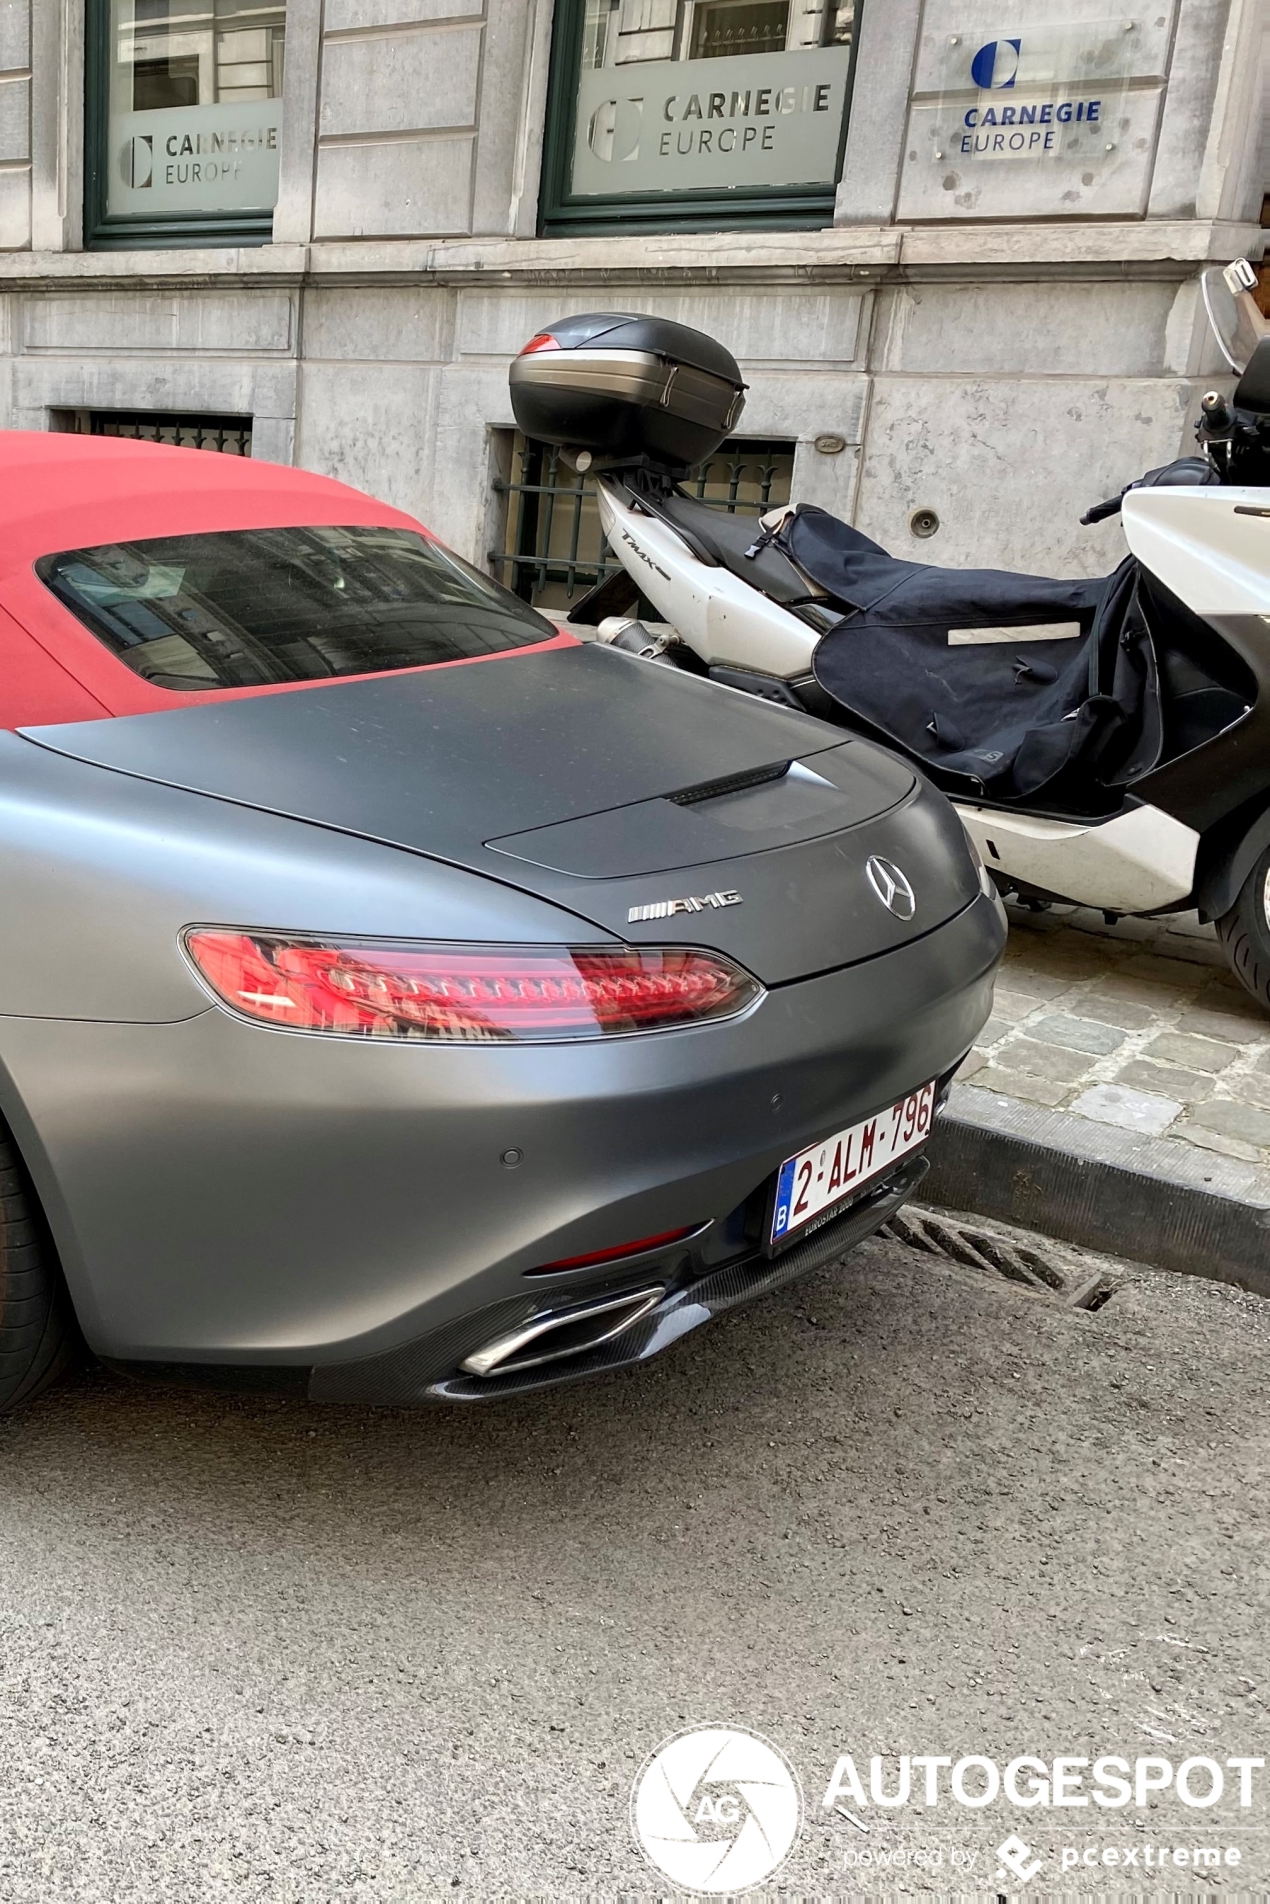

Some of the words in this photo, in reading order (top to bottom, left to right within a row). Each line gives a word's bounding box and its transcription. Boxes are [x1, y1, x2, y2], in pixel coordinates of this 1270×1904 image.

[663, 84, 831, 122] CARNEGIE
[964, 101, 1102, 128] CARNEGIE
[659, 125, 776, 156] EUROPE
[960, 131, 1056, 153] EUROPE
[667, 889, 744, 917] AMG
[776, 1204, 788, 1232] B
